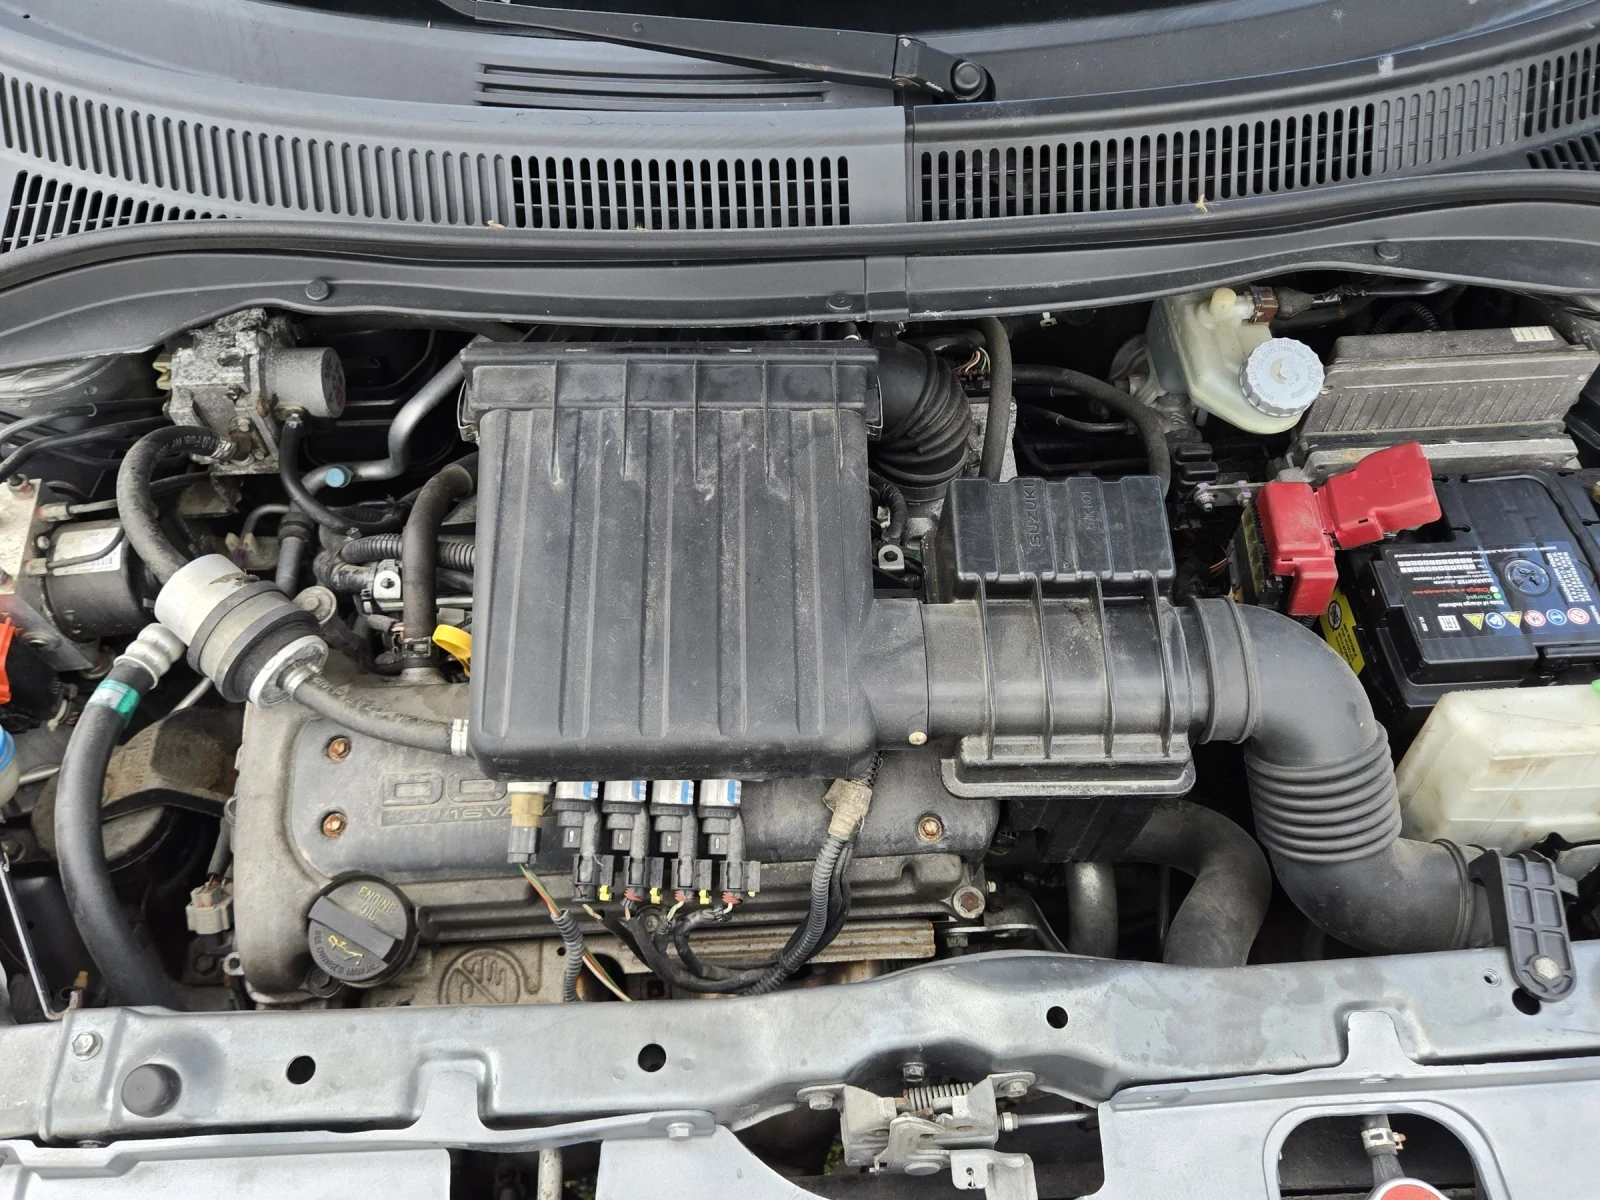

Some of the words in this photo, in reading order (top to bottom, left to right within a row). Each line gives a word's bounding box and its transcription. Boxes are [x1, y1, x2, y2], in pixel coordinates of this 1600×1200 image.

[1024, 483, 1042, 547] SUZUKI
[381, 771, 508, 807] DO
[358, 885, 399, 917] ENGINE
[360, 903, 377, 922] OIL
[314, 929, 323, 945] SEE
[316, 946, 345, 974] OWNER'S
[346, 962, 380, 976] MANUAL
